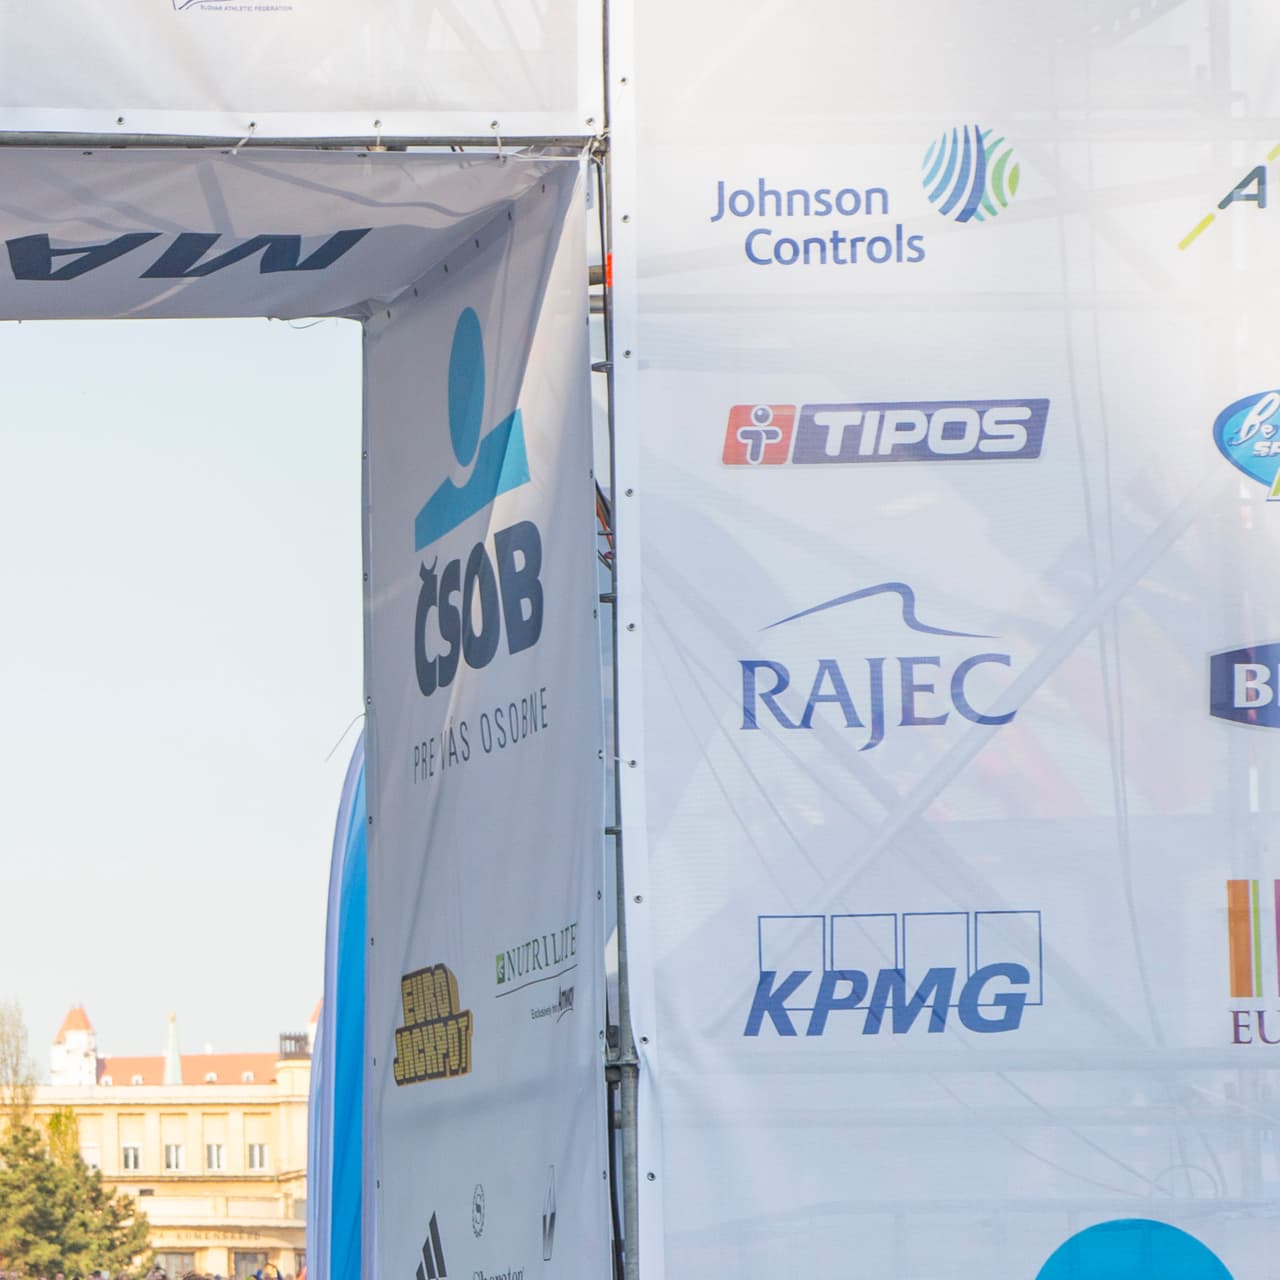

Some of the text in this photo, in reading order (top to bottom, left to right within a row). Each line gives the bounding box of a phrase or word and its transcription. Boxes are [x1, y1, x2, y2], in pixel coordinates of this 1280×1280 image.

[710, 178, 889, 222] Johnson
[744, 224, 926, 266] Controls
[813, 406, 1032, 457] TIPOS
[413, 520, 544, 697] ČSOB
[738, 653, 1017, 752] RAJEC
[414, 687, 548, 785] PRE VÁS OSOBNE
[506, 922, 578, 982] NUTRILITE
[402, 966, 452, 1027] EURO
[743, 963, 1030, 1036] KPMG
[394, 1015, 469, 1083] JACKPOT
